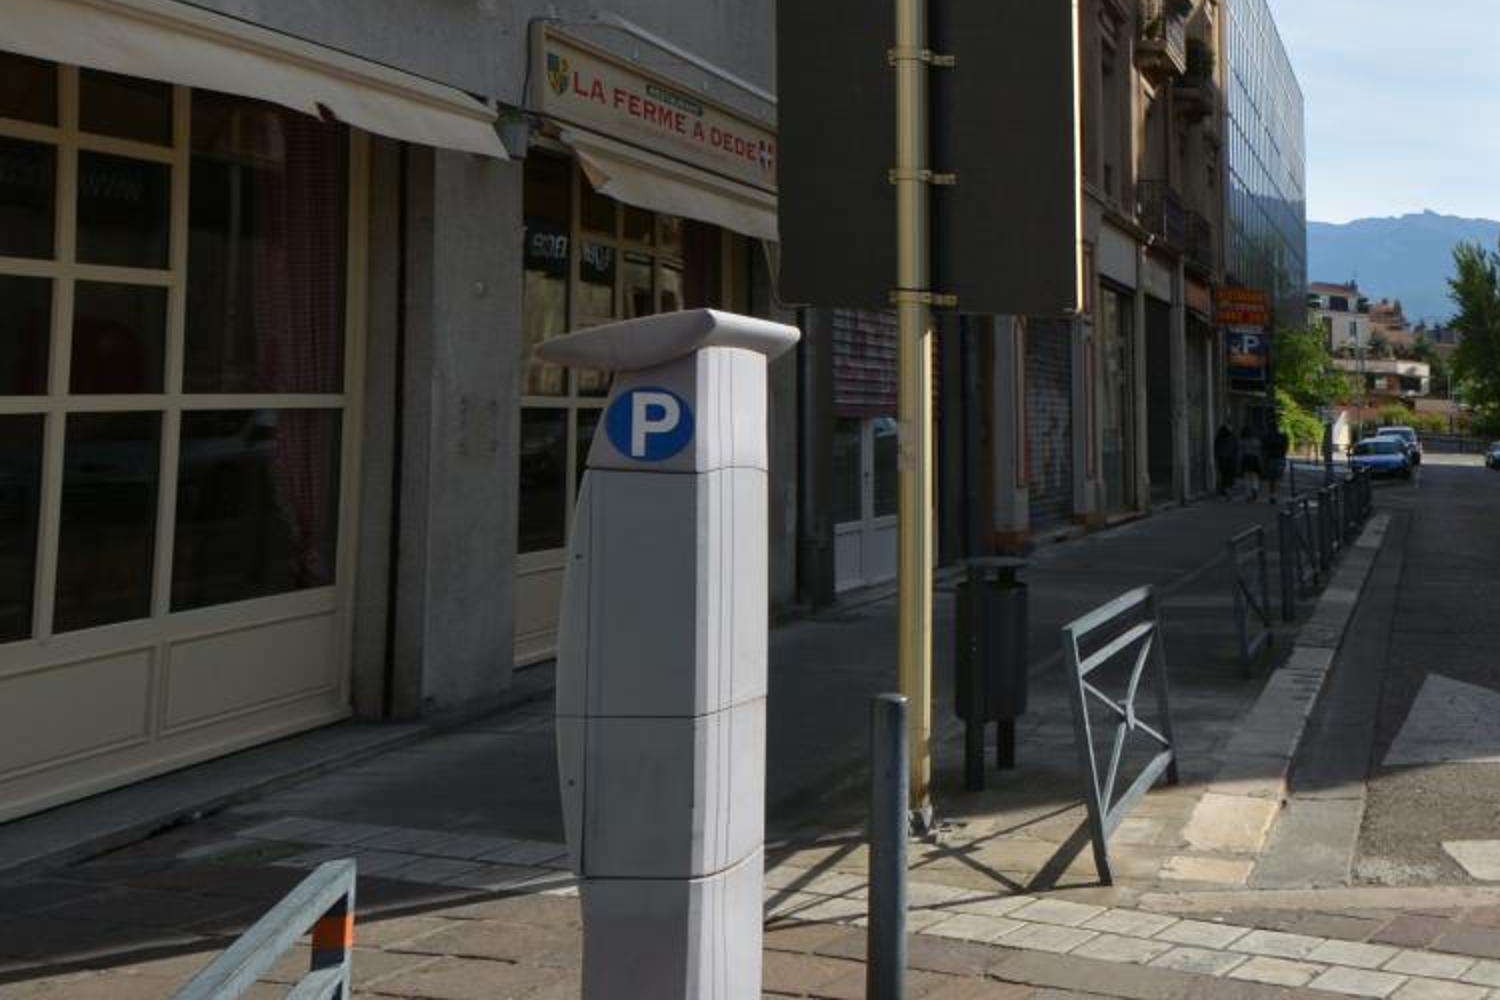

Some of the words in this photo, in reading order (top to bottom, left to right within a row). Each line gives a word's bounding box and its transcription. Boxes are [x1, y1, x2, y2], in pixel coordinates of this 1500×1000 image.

[574, 71, 606, 104] LA
[613, 87, 687, 134] FERME
[693, 121, 705, 143] A
[710, 127, 757, 161] DEDE
[631, 391, 680, 457] P
